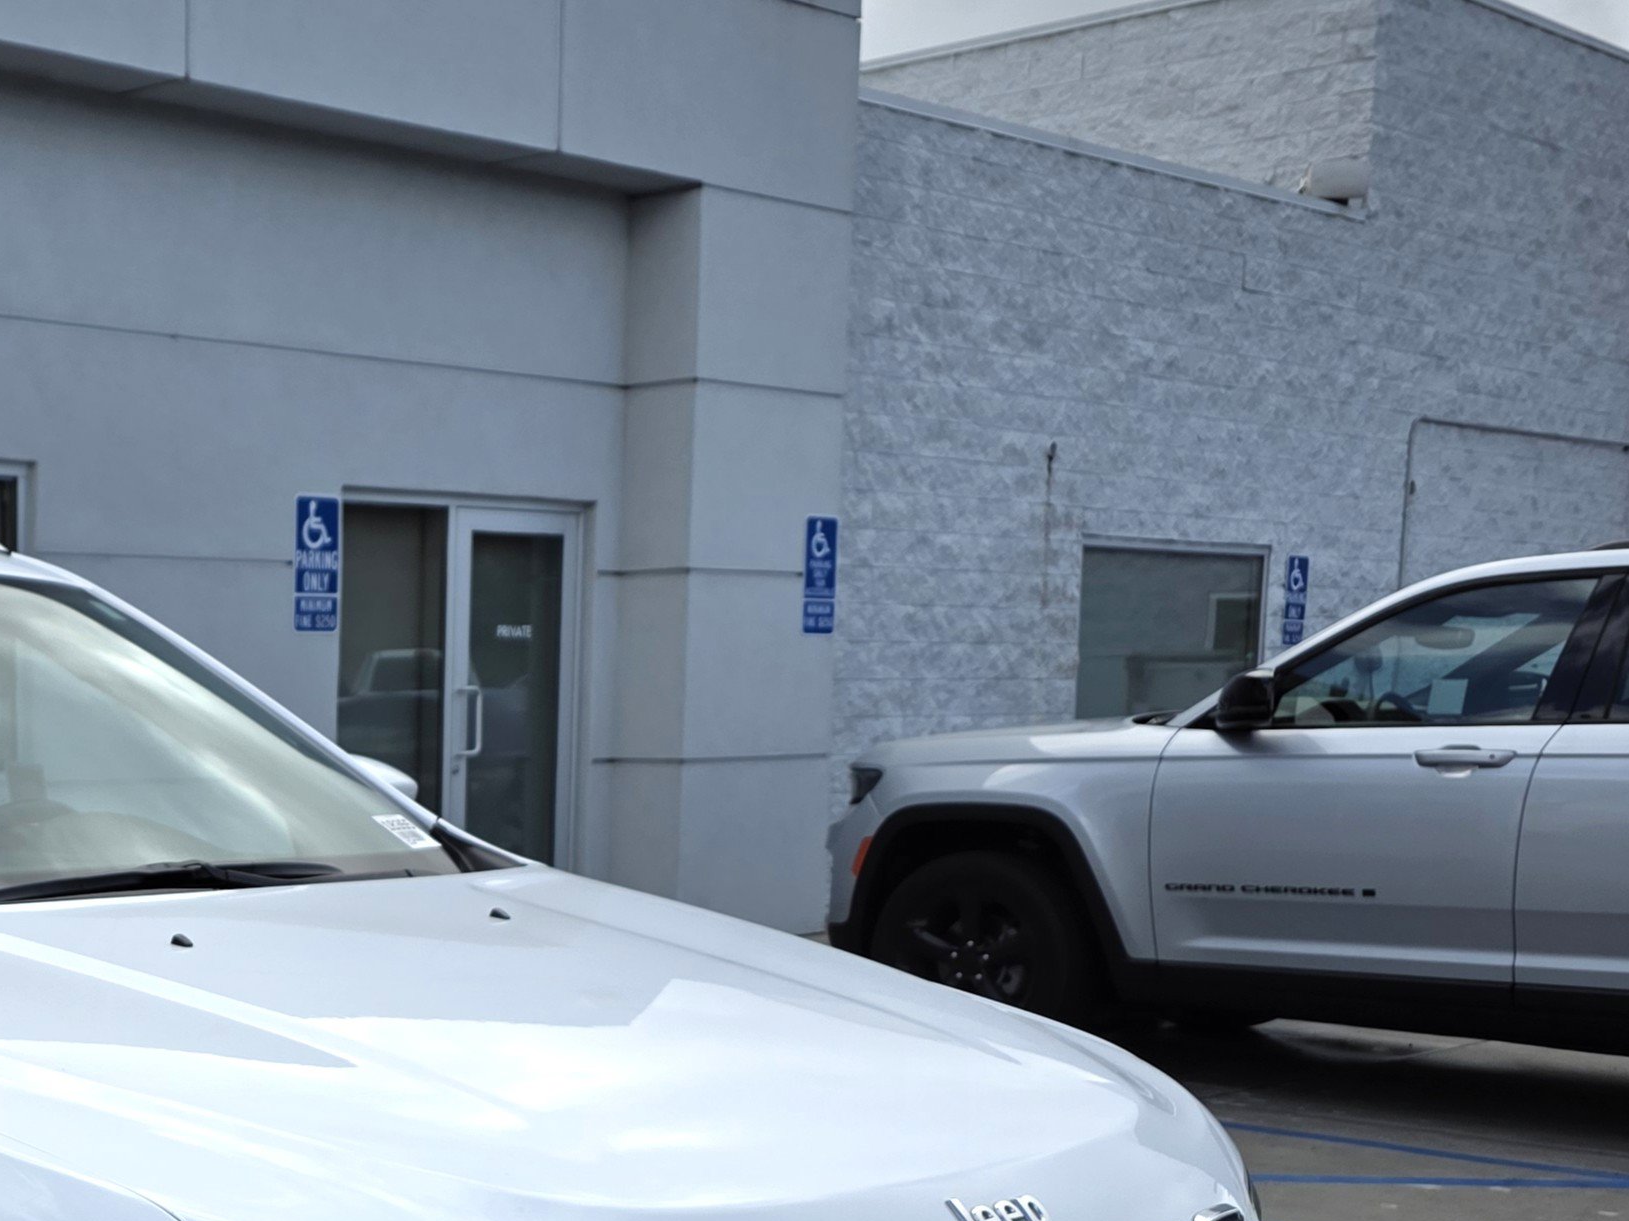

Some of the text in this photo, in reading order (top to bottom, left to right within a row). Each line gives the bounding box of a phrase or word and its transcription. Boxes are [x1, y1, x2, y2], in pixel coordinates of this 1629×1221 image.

[295, 549, 338, 570] PARKING
[303, 571, 329, 592] ONLY
[496, 624, 532, 639] PRIVATE
[1165, 882, 1235, 893] GRAND
[1240, 883, 1356, 897] CHEROKEE
